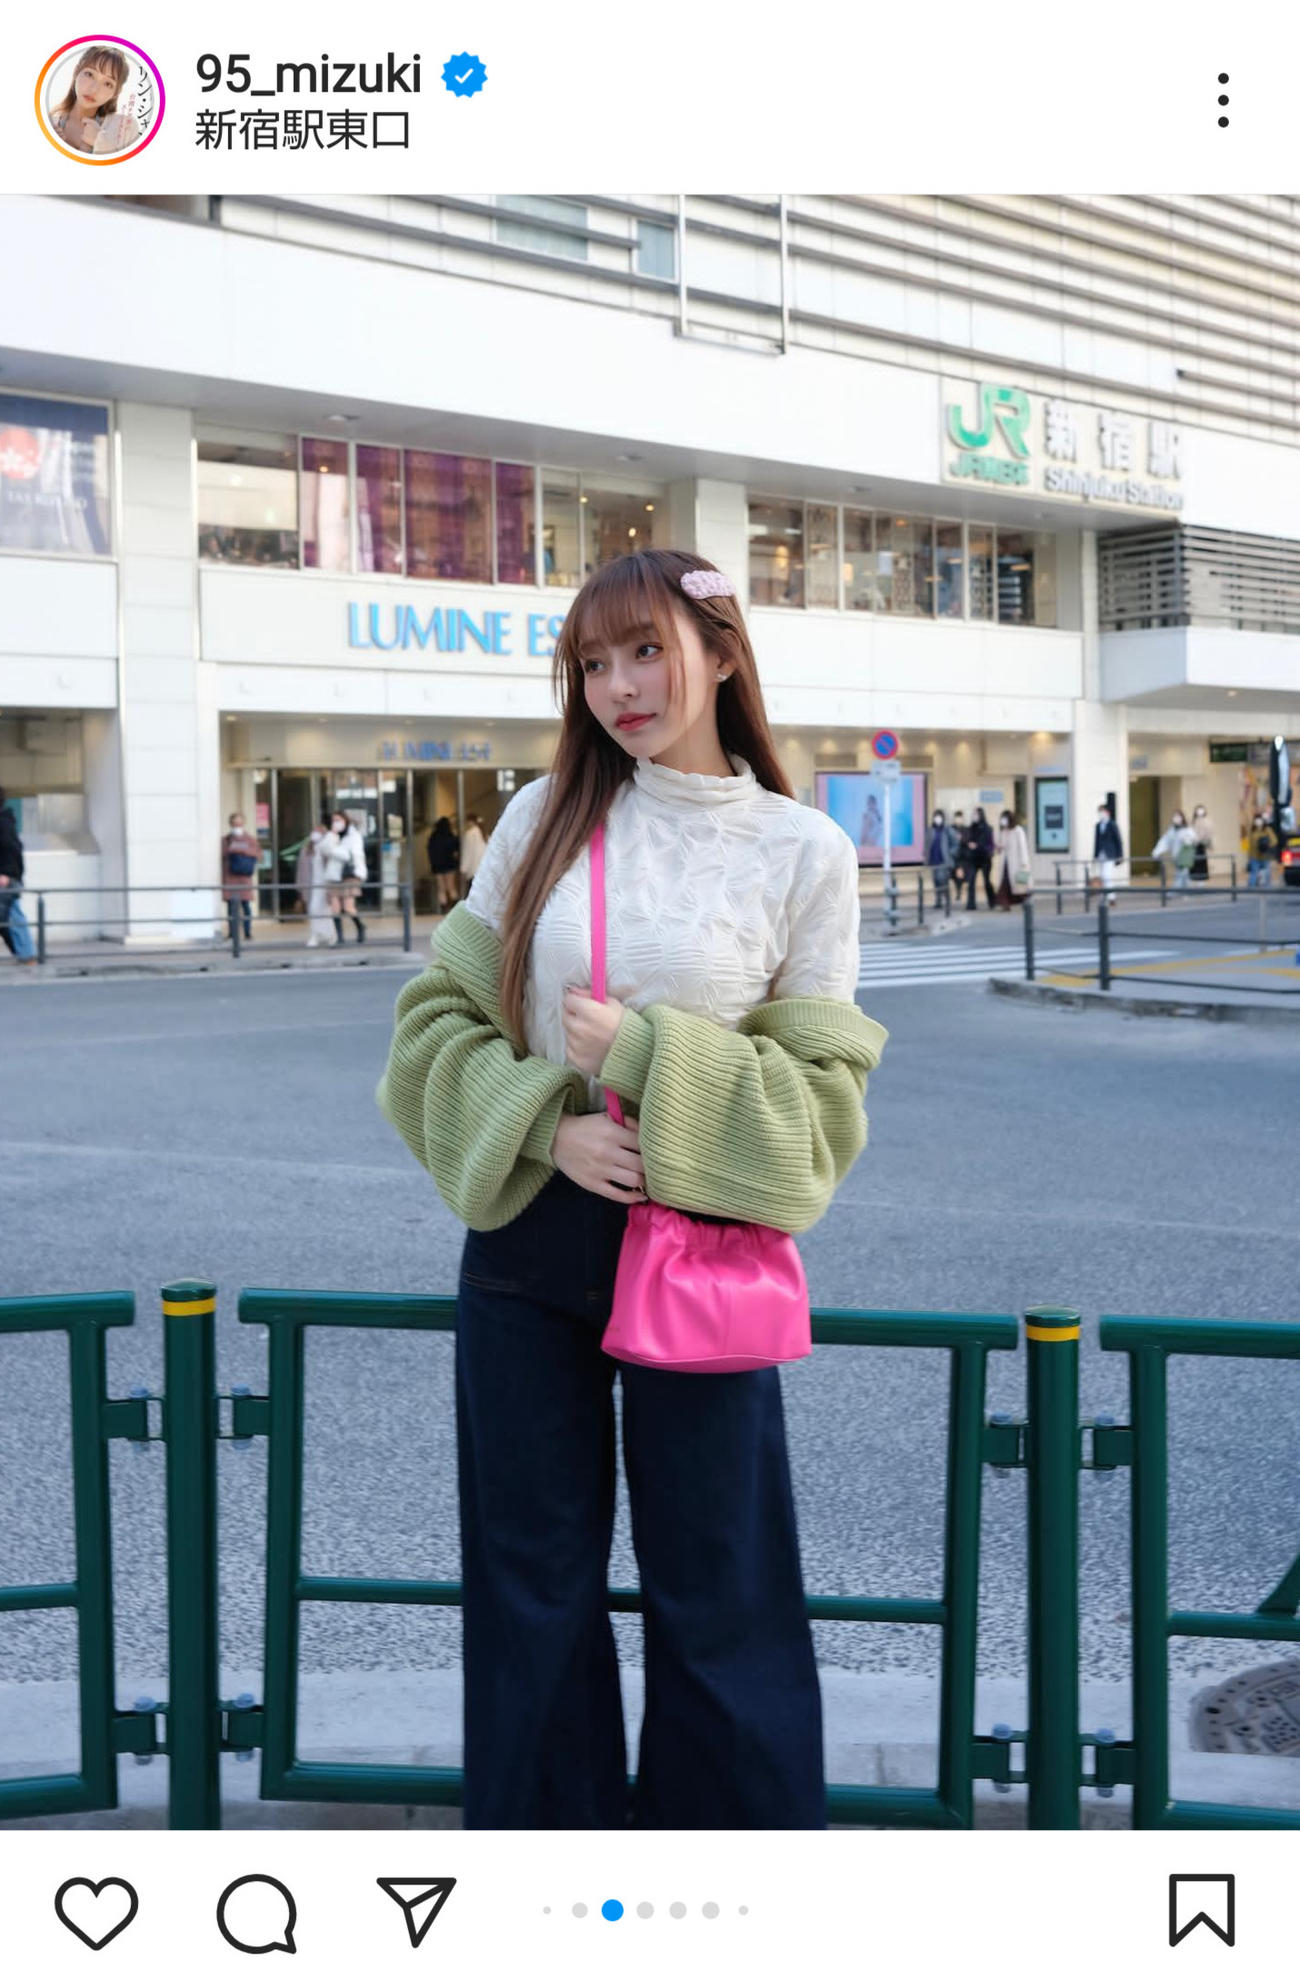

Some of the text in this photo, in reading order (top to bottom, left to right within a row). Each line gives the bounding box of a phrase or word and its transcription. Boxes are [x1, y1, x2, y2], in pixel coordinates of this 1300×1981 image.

[947, 383, 1031, 460] JR
[1044, 467, 1183, 511] Shinjuku Station
[348, 601, 567, 657] LUMINE ES
